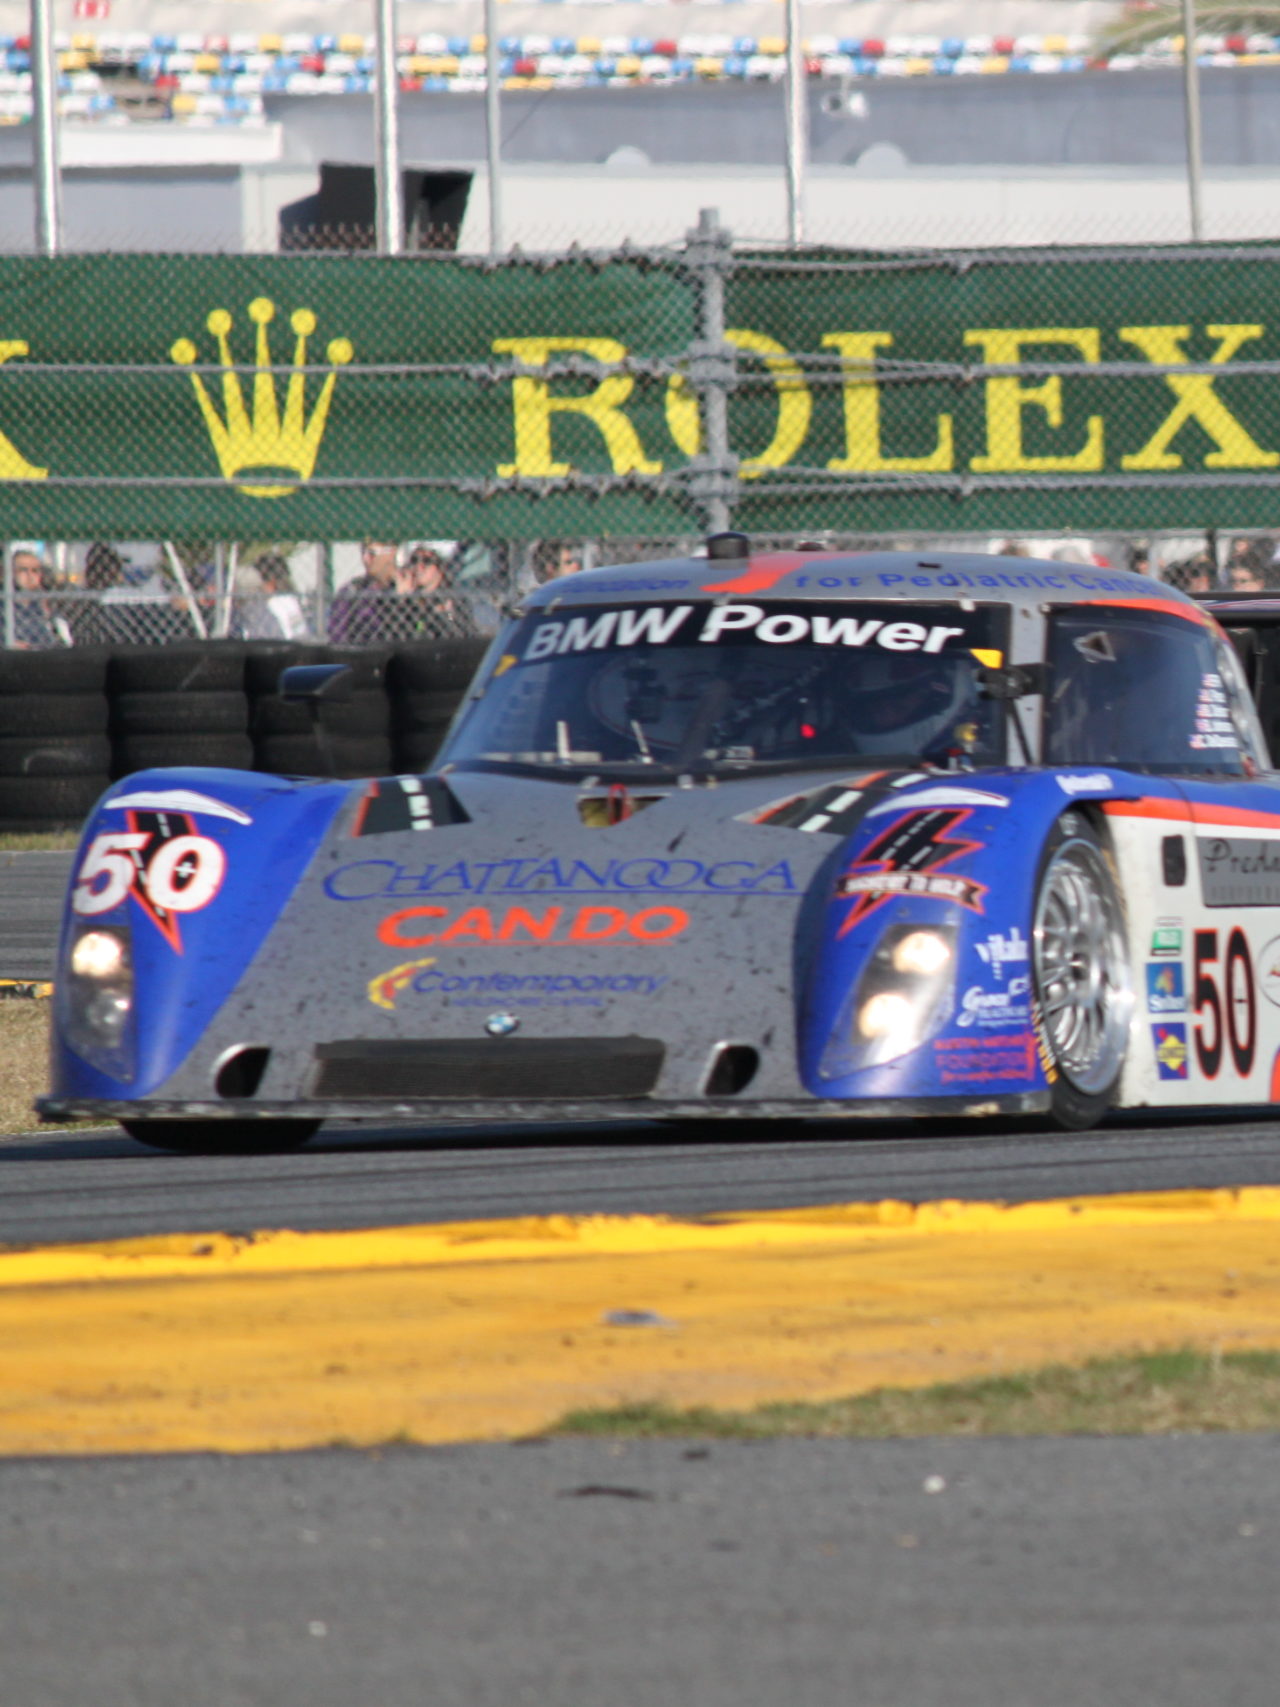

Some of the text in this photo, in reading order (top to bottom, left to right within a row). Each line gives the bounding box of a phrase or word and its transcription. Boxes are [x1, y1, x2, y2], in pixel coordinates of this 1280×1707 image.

[493, 324, 1280, 478] ROLEX
[794, 576, 860, 588] for
[877, 572, 1064, 588] Pediatric
[525, 604, 963, 662] BMW Power
[72, 832, 227, 916] 50
[322, 857, 798, 901] CHATTANOOGA
[376, 905, 691, 948] CAN DO
[412, 970, 668, 995] Contemporary
[1193, 925, 1258, 1081] 50
